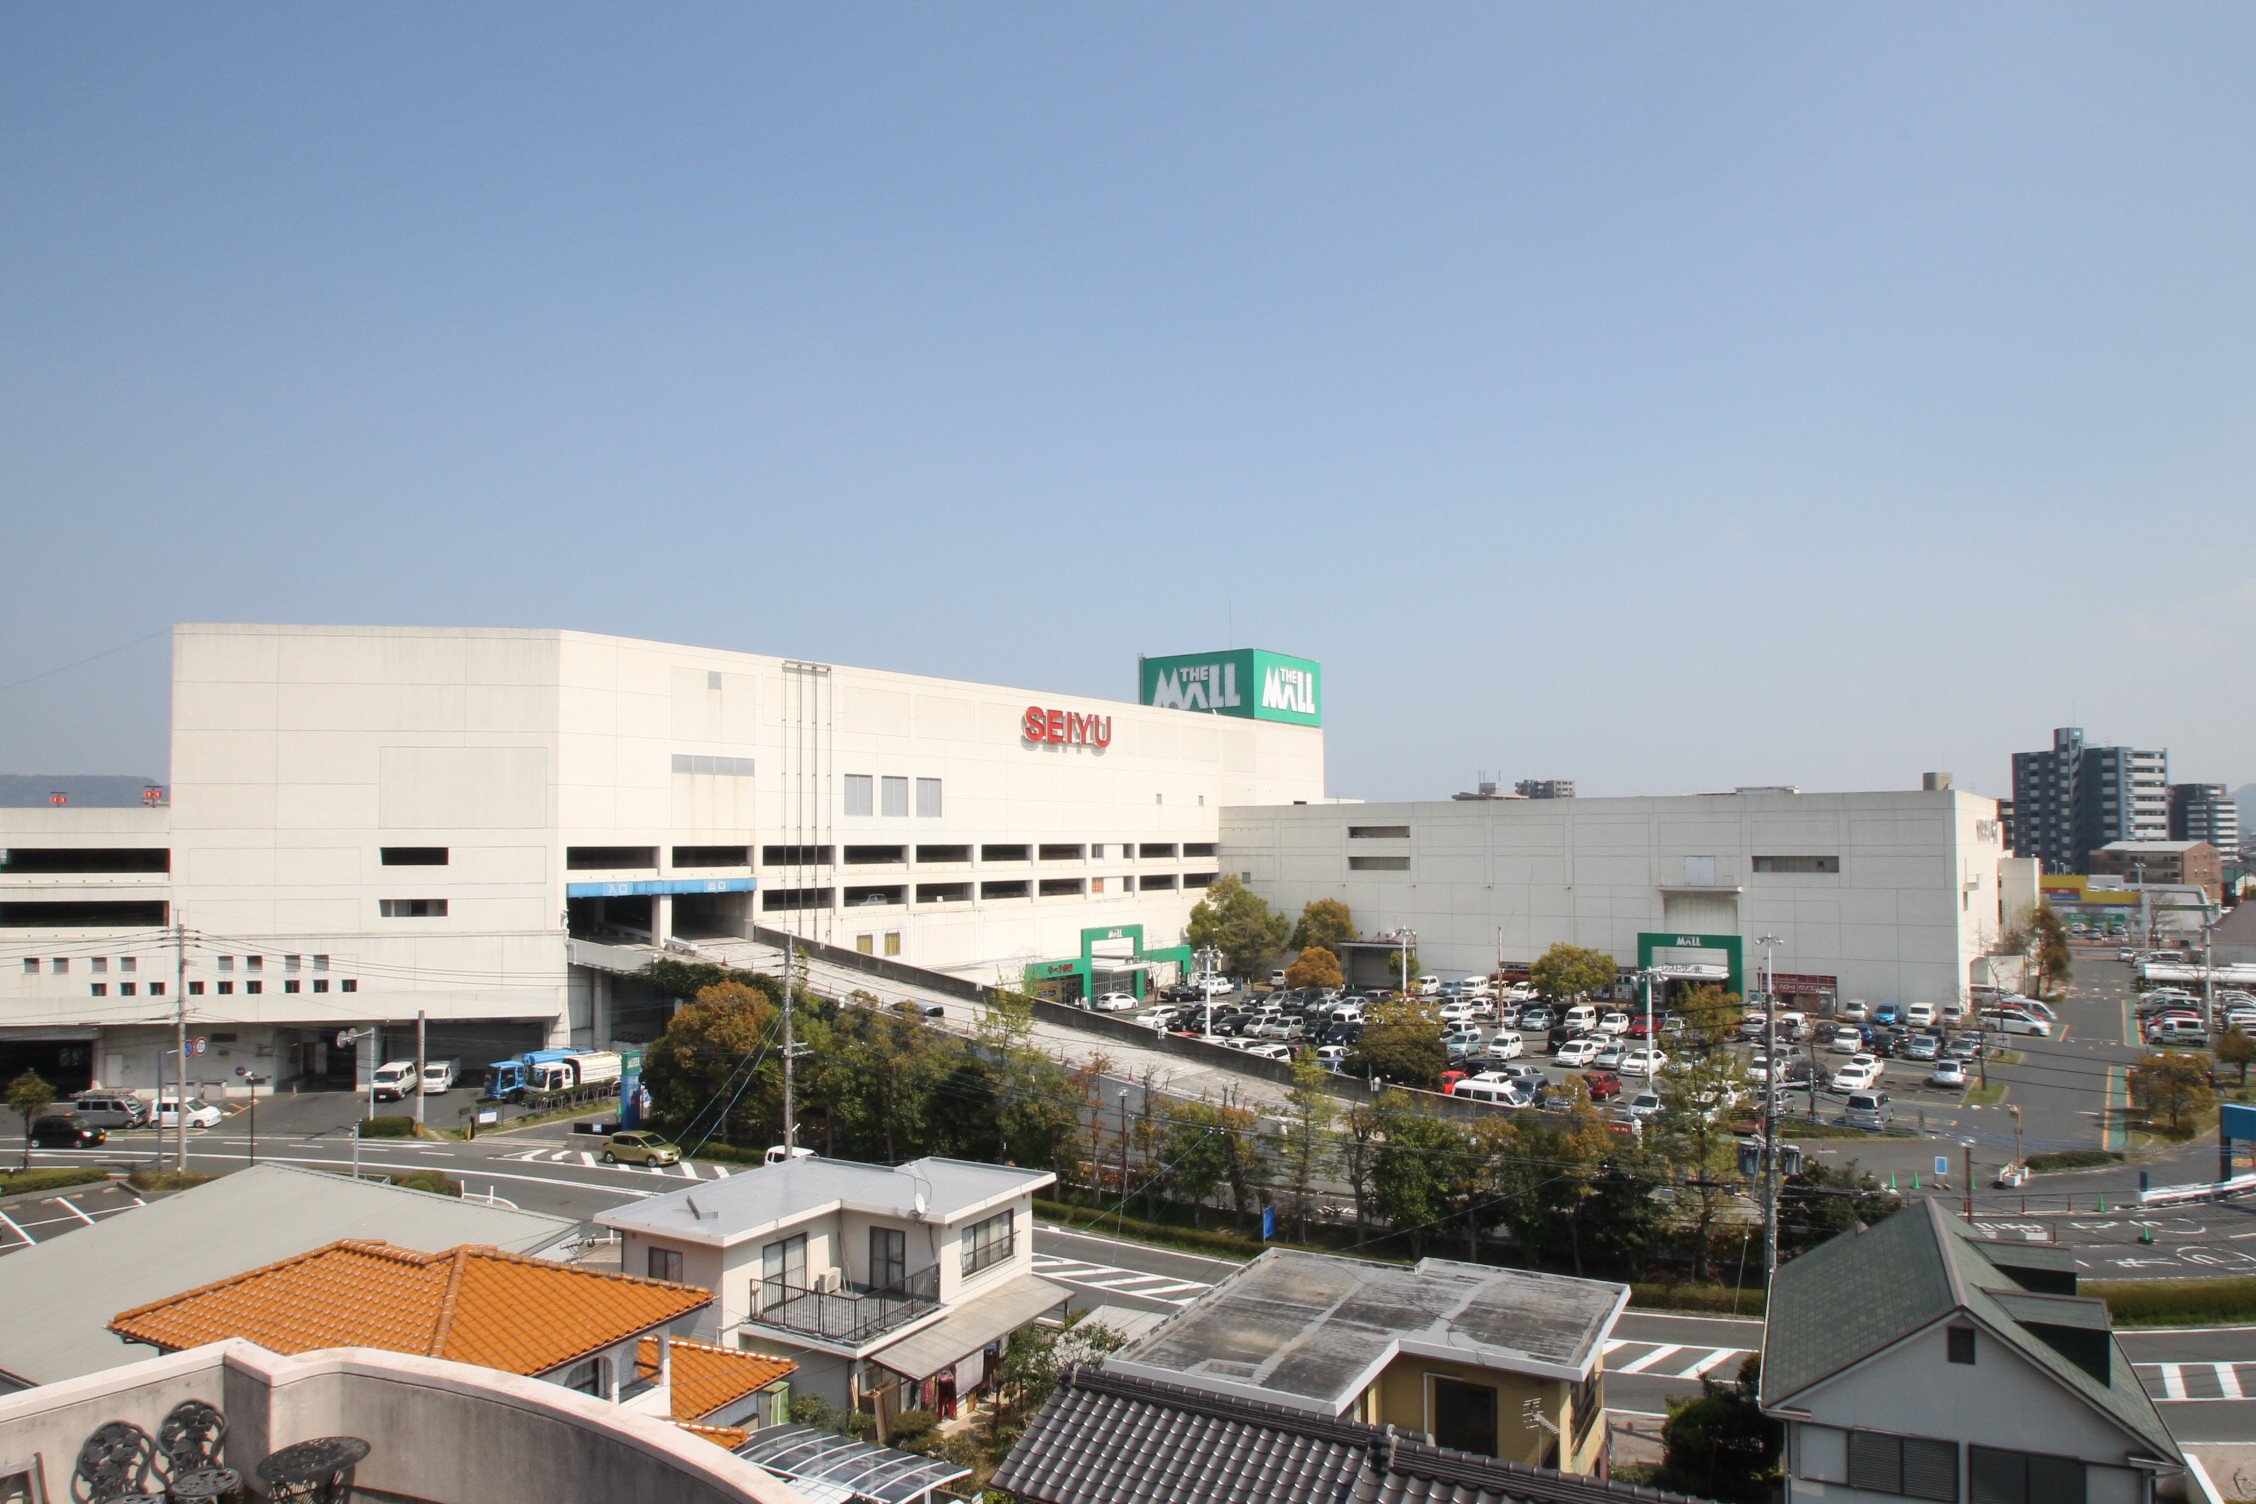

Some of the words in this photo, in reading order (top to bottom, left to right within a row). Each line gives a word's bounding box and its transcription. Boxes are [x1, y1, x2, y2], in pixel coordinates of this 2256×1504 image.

[1179, 666, 1209, 682] THE
[1279, 667, 1298, 684] THE
[1152, 663, 1241, 711] MALL
[1261, 663, 1316, 715] MALL
[1025, 706, 1112, 748] SEIYU
[608, 884, 628, 894] 入口
[707, 881, 727, 891] 出口
[1676, 935, 1701, 946] MALL
